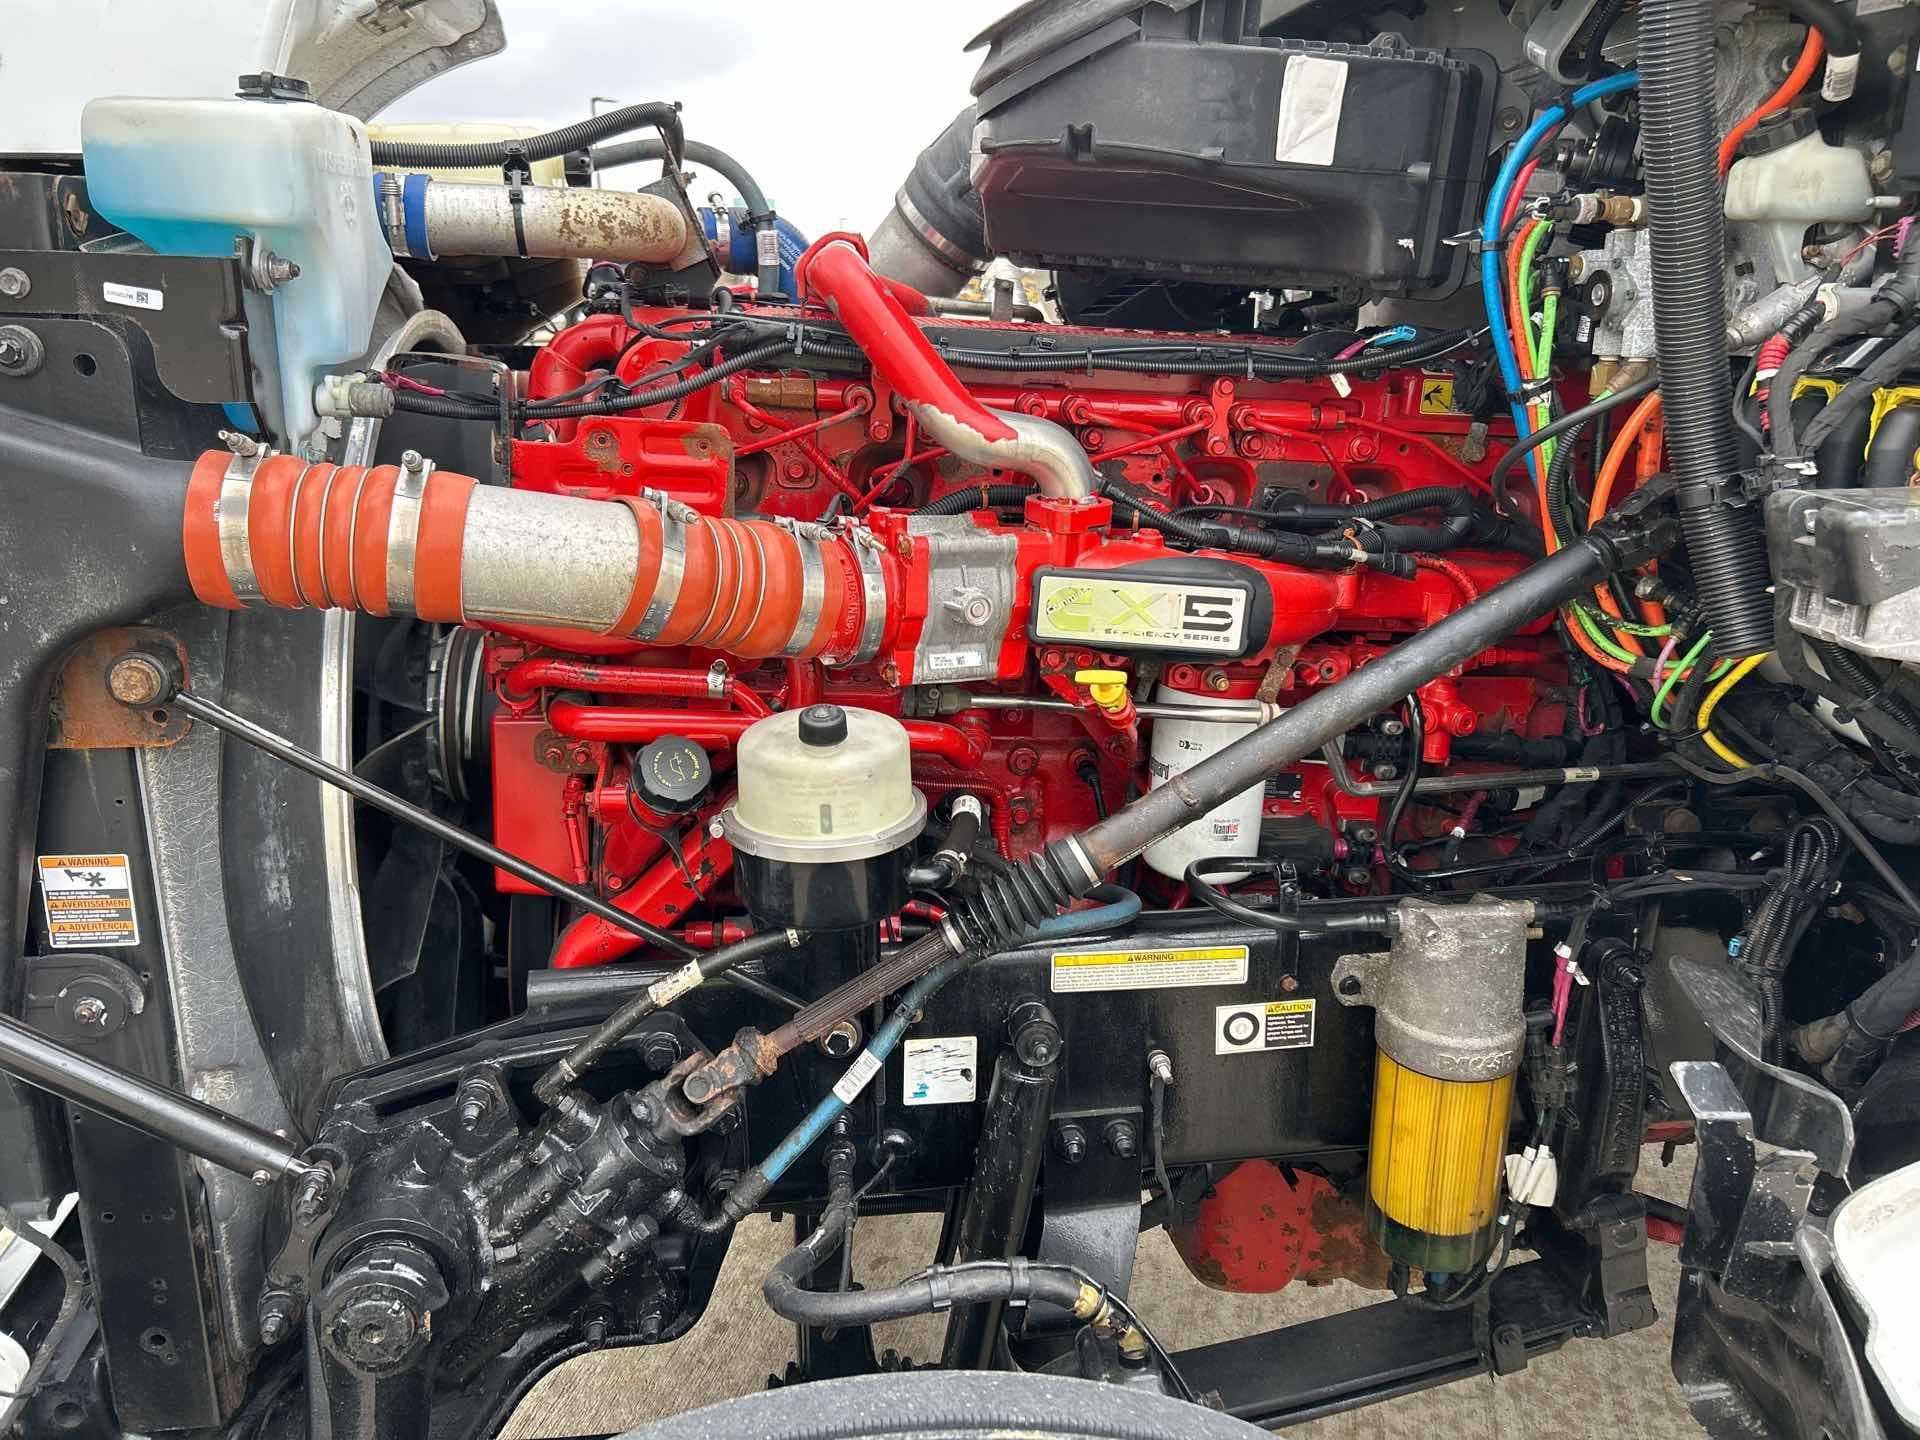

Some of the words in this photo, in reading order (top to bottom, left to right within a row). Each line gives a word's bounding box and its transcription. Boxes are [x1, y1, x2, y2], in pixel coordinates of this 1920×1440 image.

[1184, 634, 1231, 643] SERIES
[67, 857, 110, 866] WARNING
[62, 900, 129, 909] AVERTISSEMENT
[69, 922, 129, 931] ADVERTENCIA
[1134, 953, 1174, 962] WARNING
[1274, 1003, 1312, 1013] CAUTION
